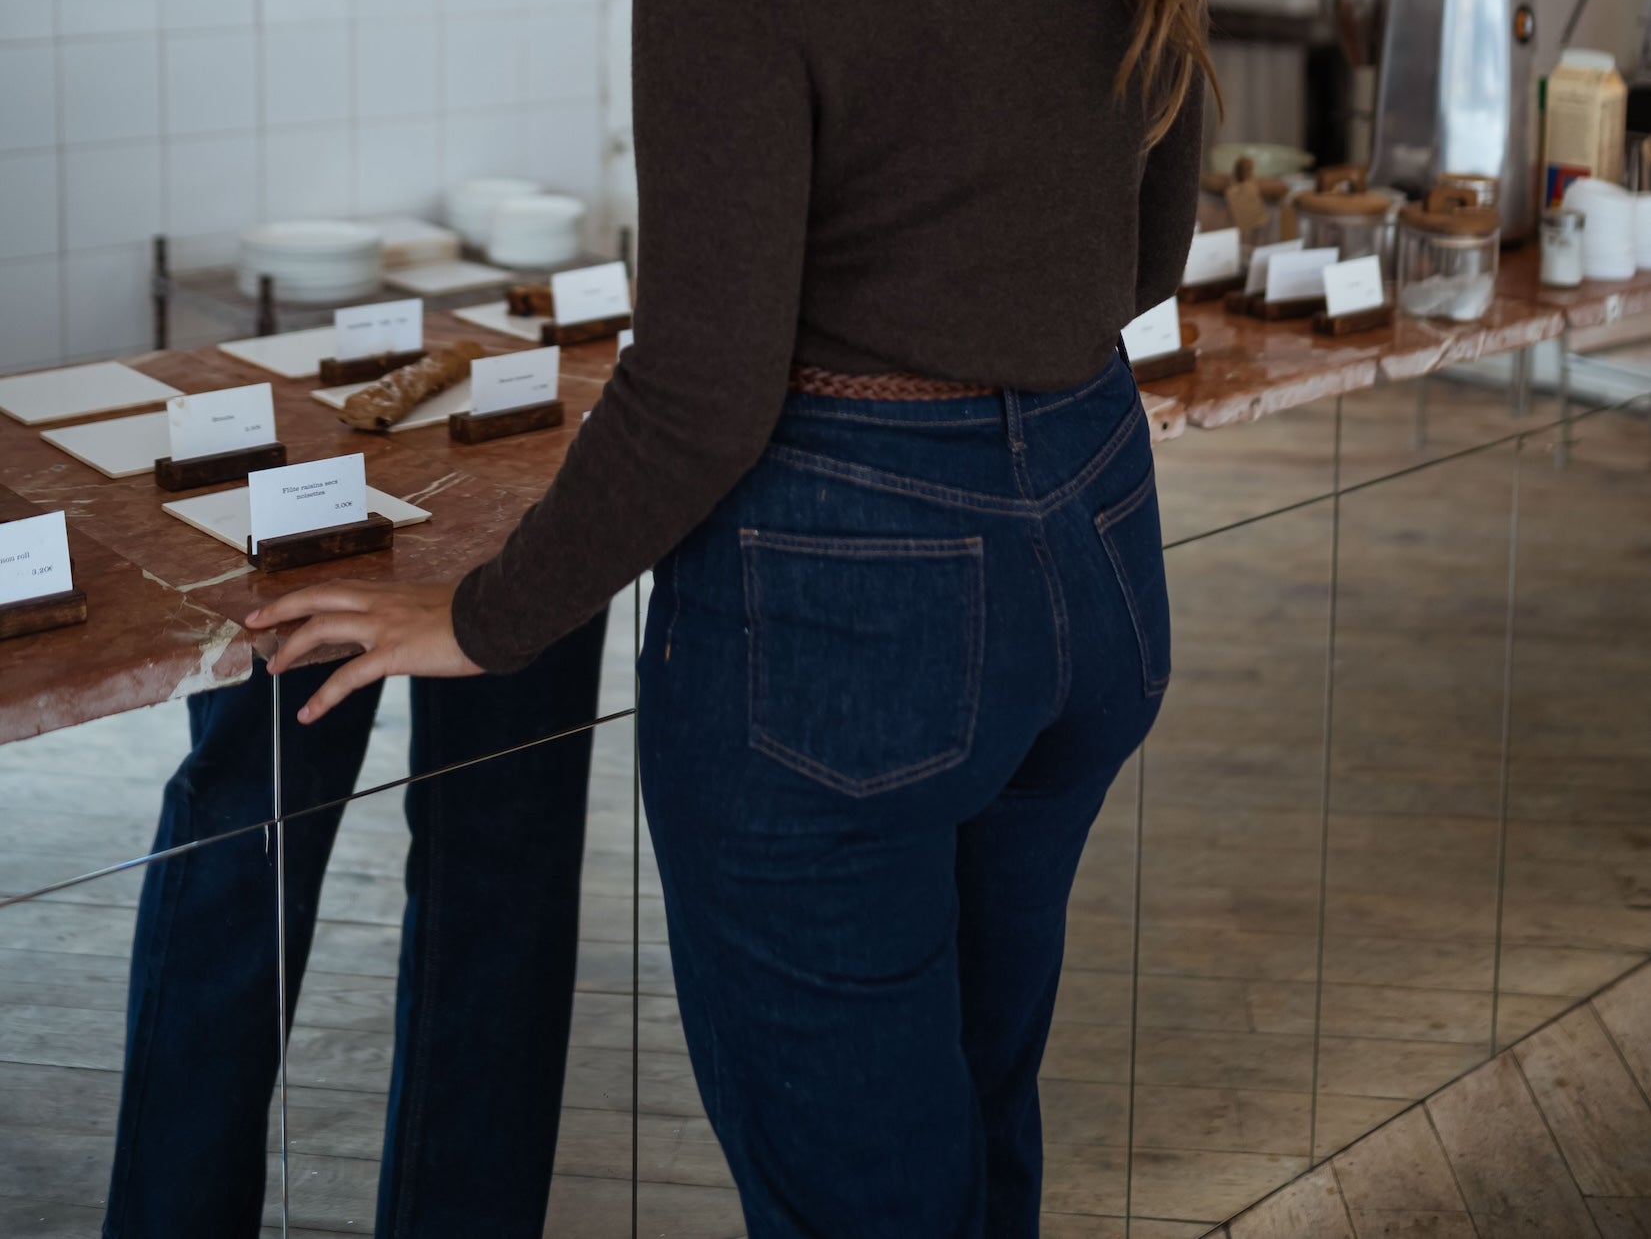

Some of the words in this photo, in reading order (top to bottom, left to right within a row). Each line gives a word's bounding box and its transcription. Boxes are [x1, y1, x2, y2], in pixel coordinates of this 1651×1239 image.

[301, 483, 324, 491] raisins
[296, 491, 325, 500] noisettes
[17, 552, 30, 560] roll
